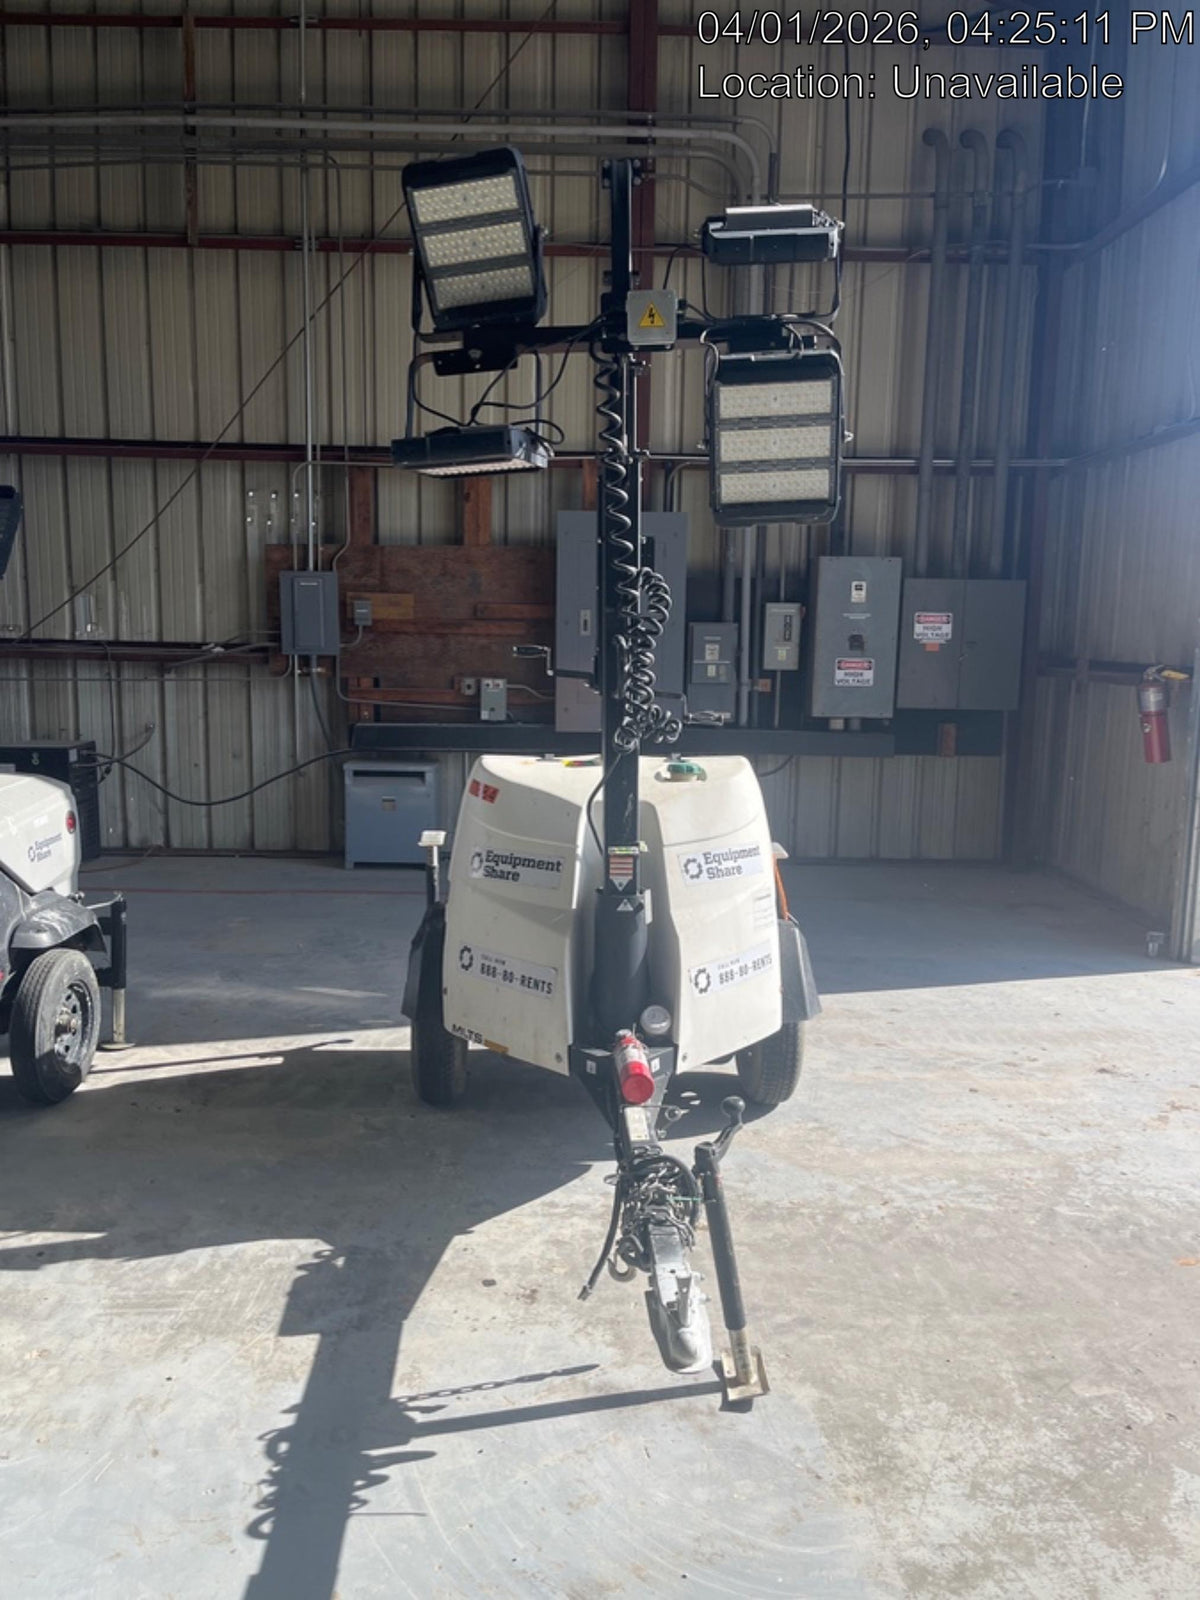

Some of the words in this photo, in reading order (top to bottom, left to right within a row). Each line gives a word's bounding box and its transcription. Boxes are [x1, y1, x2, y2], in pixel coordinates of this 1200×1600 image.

[485, 849, 562, 873] Equipment
[702, 845, 760, 865] Equipment
[483, 865, 520, 882] Share
[706, 864, 743, 880] Share
[481, 963, 553, 994] 888-80-RENTS
